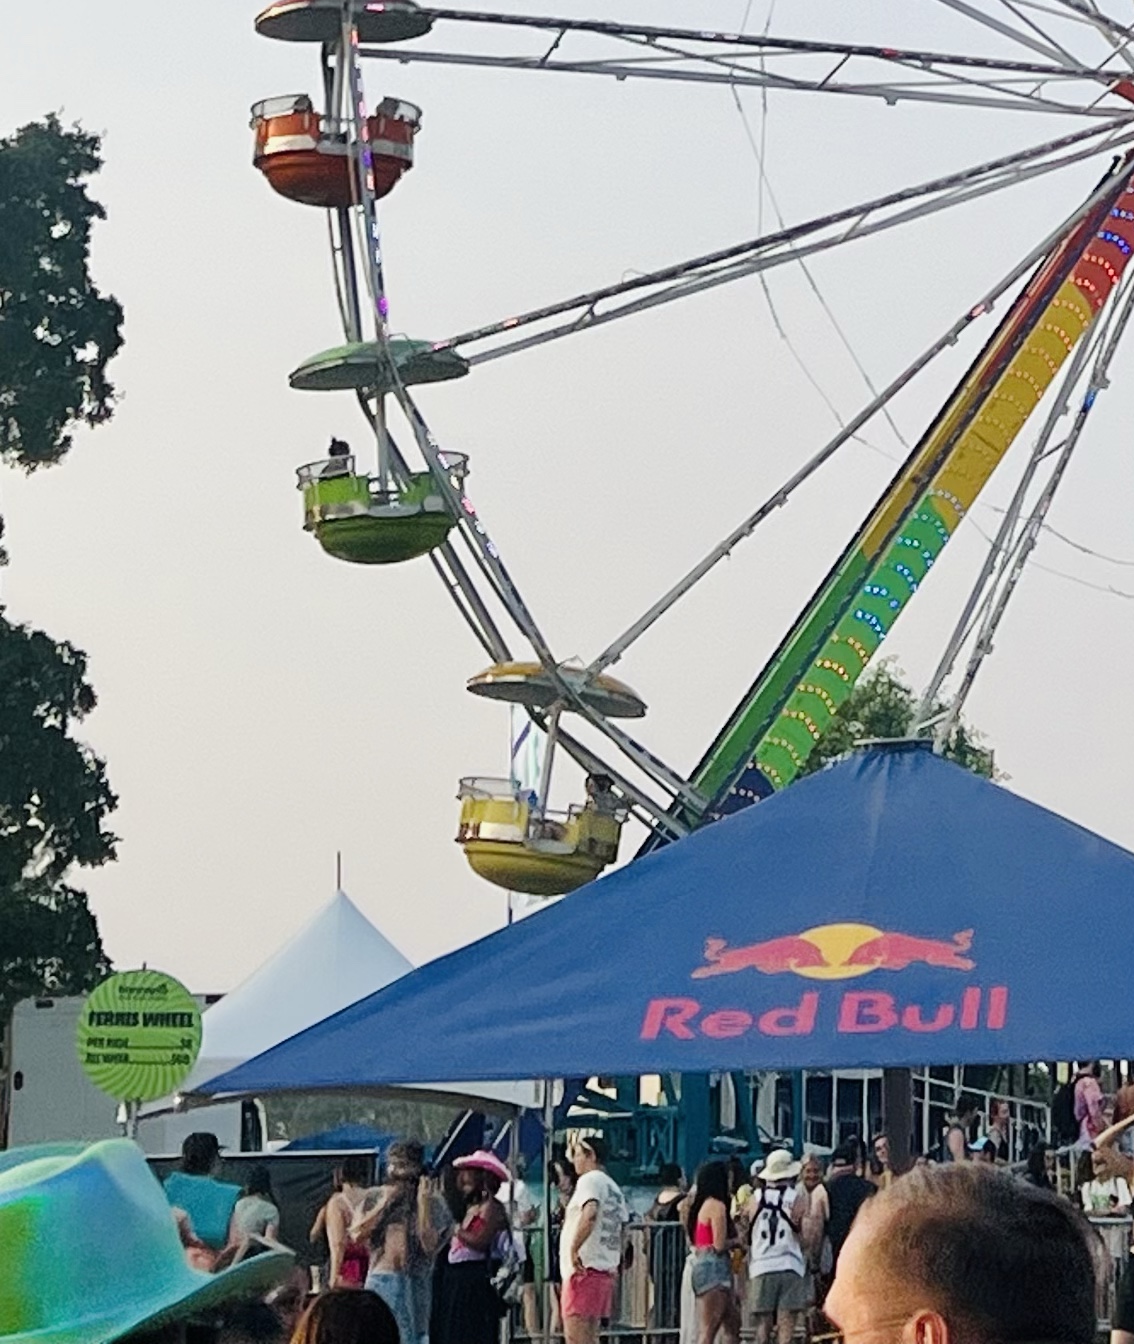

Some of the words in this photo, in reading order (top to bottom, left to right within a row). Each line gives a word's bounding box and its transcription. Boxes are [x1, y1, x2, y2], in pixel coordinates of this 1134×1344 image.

[88, 1010, 140, 1027] FERRIS
[142, 1011, 194, 1028] WHEEL
[640, 990, 820, 1041] Red
[836, 985, 1009, 1034] Bull
